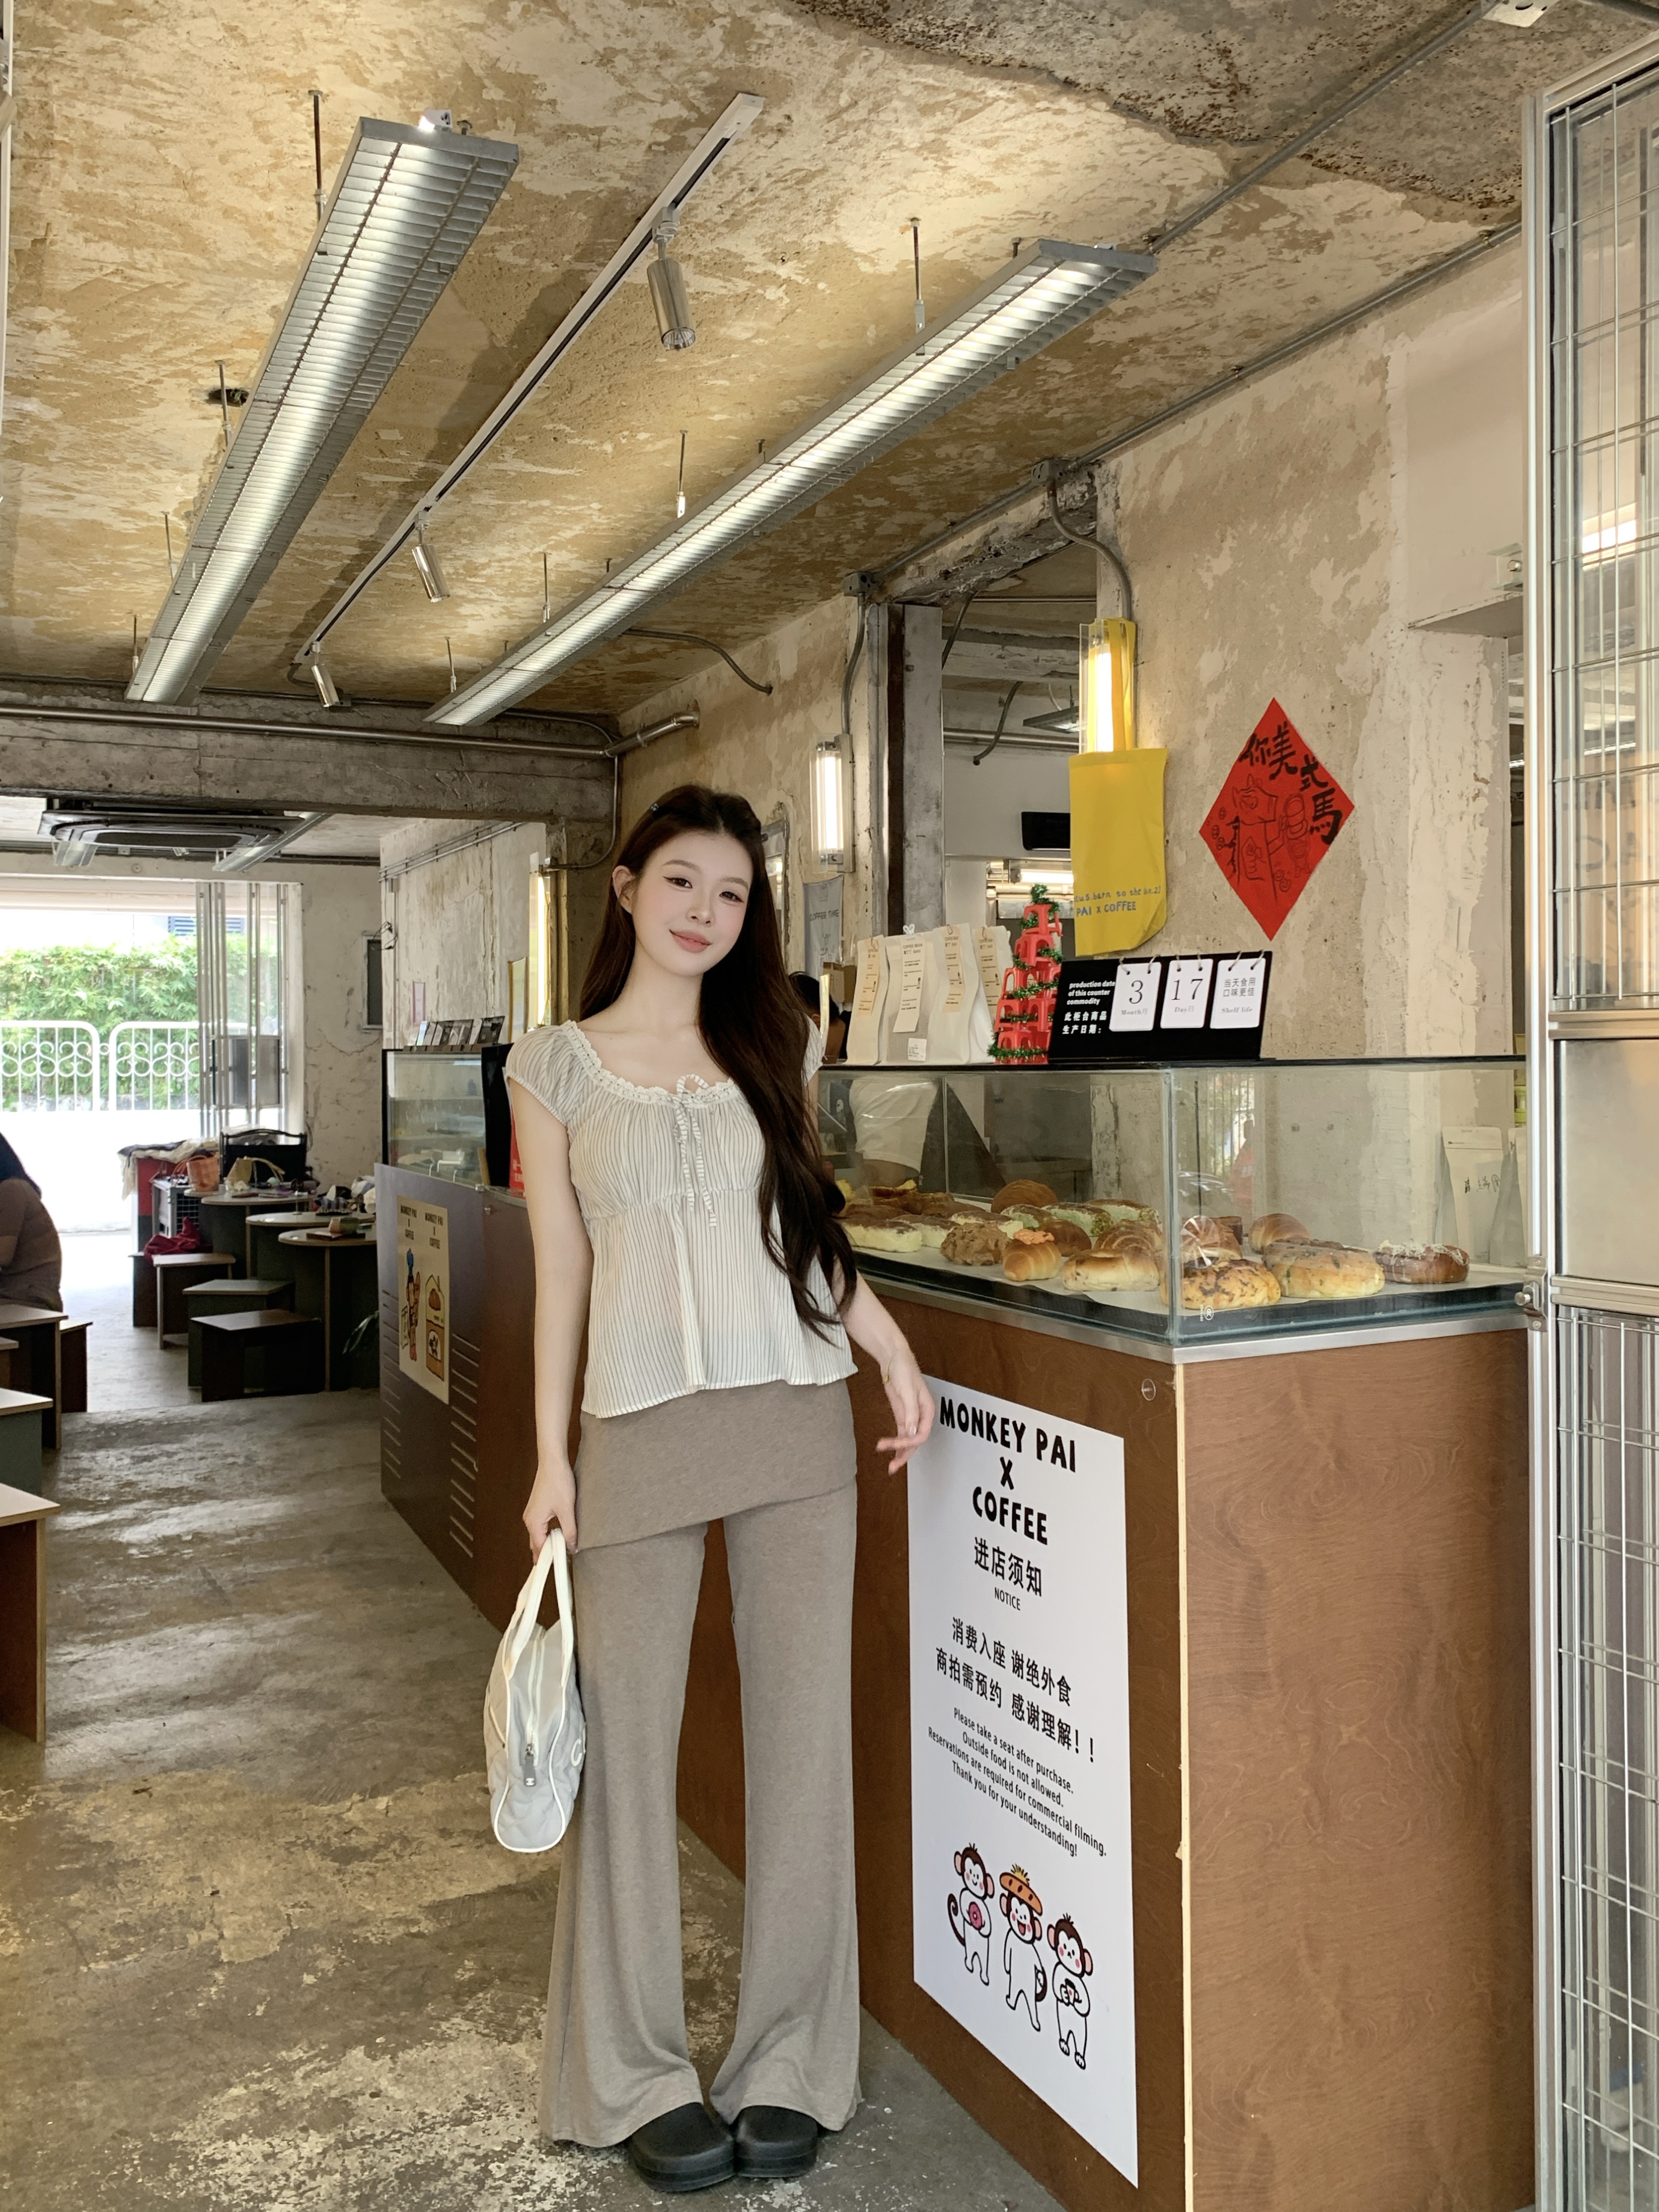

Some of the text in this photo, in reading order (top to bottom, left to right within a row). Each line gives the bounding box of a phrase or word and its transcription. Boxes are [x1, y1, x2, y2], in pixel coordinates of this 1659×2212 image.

[809, 911, 827, 921] COFFEE
[1076, 907, 1092, 916] PAI
[1104, 901, 1136, 912] COFFEE
[1069, 981, 1102, 989] production
[1129, 980, 1143, 1003] 3
[1223, 988, 1254, 997] 口味更佳
[1224, 978, 1256, 987] 当天食用
[1064, 1011, 1107, 1021] 此柜台商品
[940, 1397, 1076, 1472] MONKEY PAI
[1000, 1457, 1014, 1490] X
[973, 1486, 1047, 1545] COFFEE
[974, 1537, 1042, 1596] 进店须知
[995, 1587, 1020, 1611] NOTICE
[936, 1647, 1001, 1708] 商拍需预约
[952, 1617, 1071, 1706] 消费入座 谢绝外食
[954, 1708, 1073, 1794] Please take a seat after purchase.
[963, 1732, 1063, 1807] Outside food is not allowed.
[928, 1727, 1106, 1857] Reservations are required for commercial filming.
[952, 1760, 1077, 1857] Thank you for your understanding!
